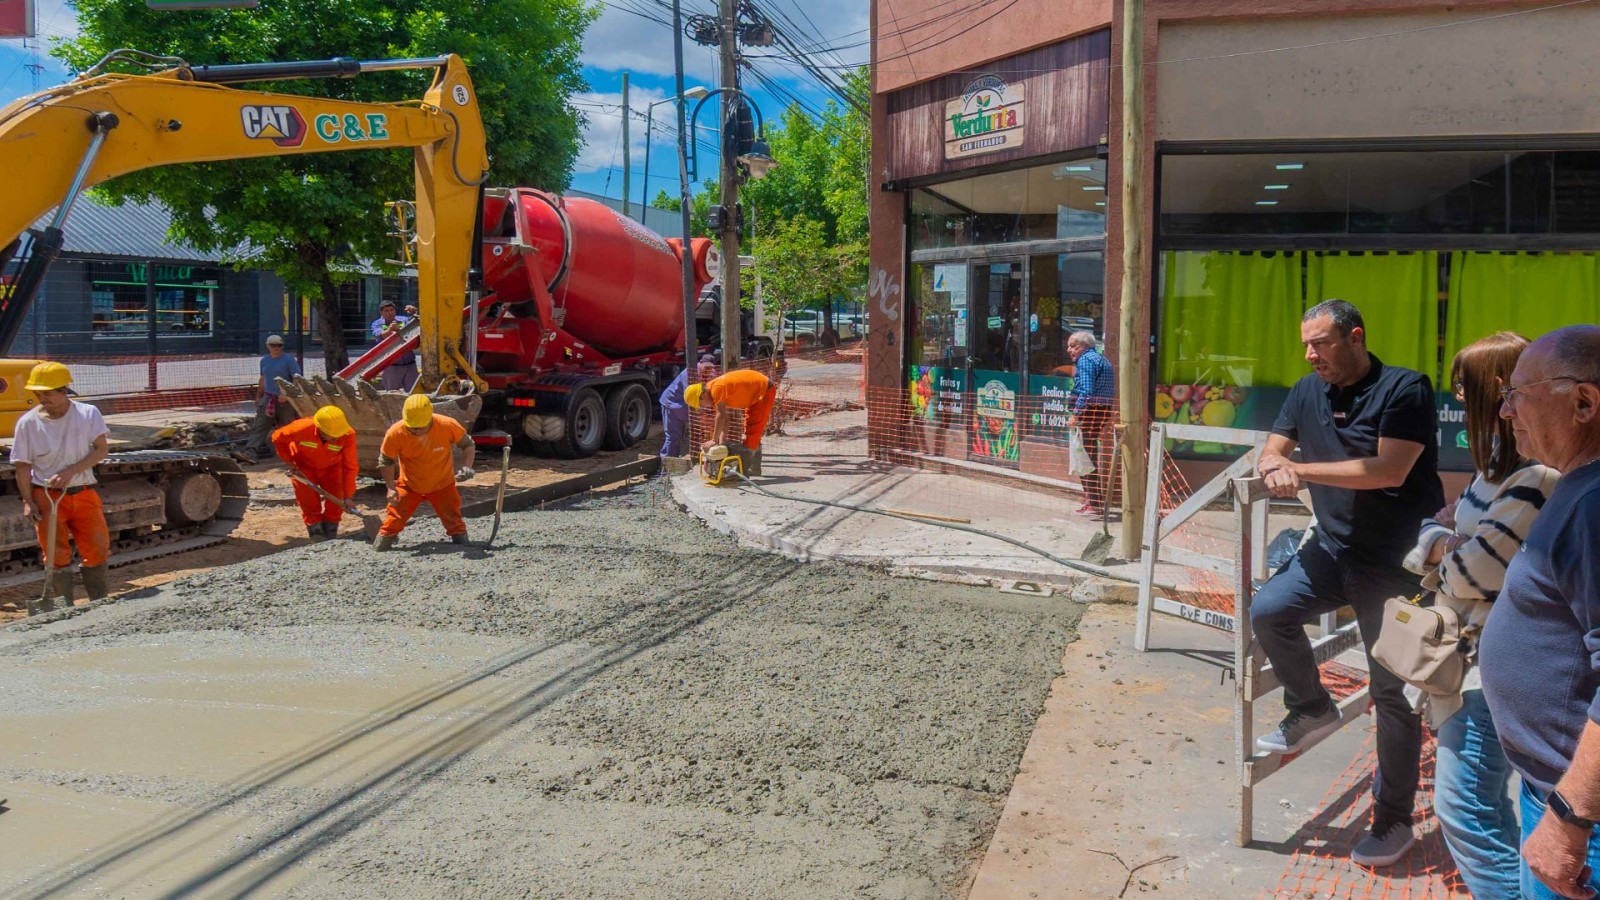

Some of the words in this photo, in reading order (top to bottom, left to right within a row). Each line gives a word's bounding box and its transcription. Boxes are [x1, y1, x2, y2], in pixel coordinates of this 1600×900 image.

[454, 86, 465, 103] 528
[242, 106, 290, 137] CAT
[315, 113, 389, 143] C&E
[951, 104, 1017, 139] Verdurita
[961, 143, 973, 152] SAN
[974, 136, 1004, 149] FERNANDO
[1041, 385, 1064, 398] Realice
